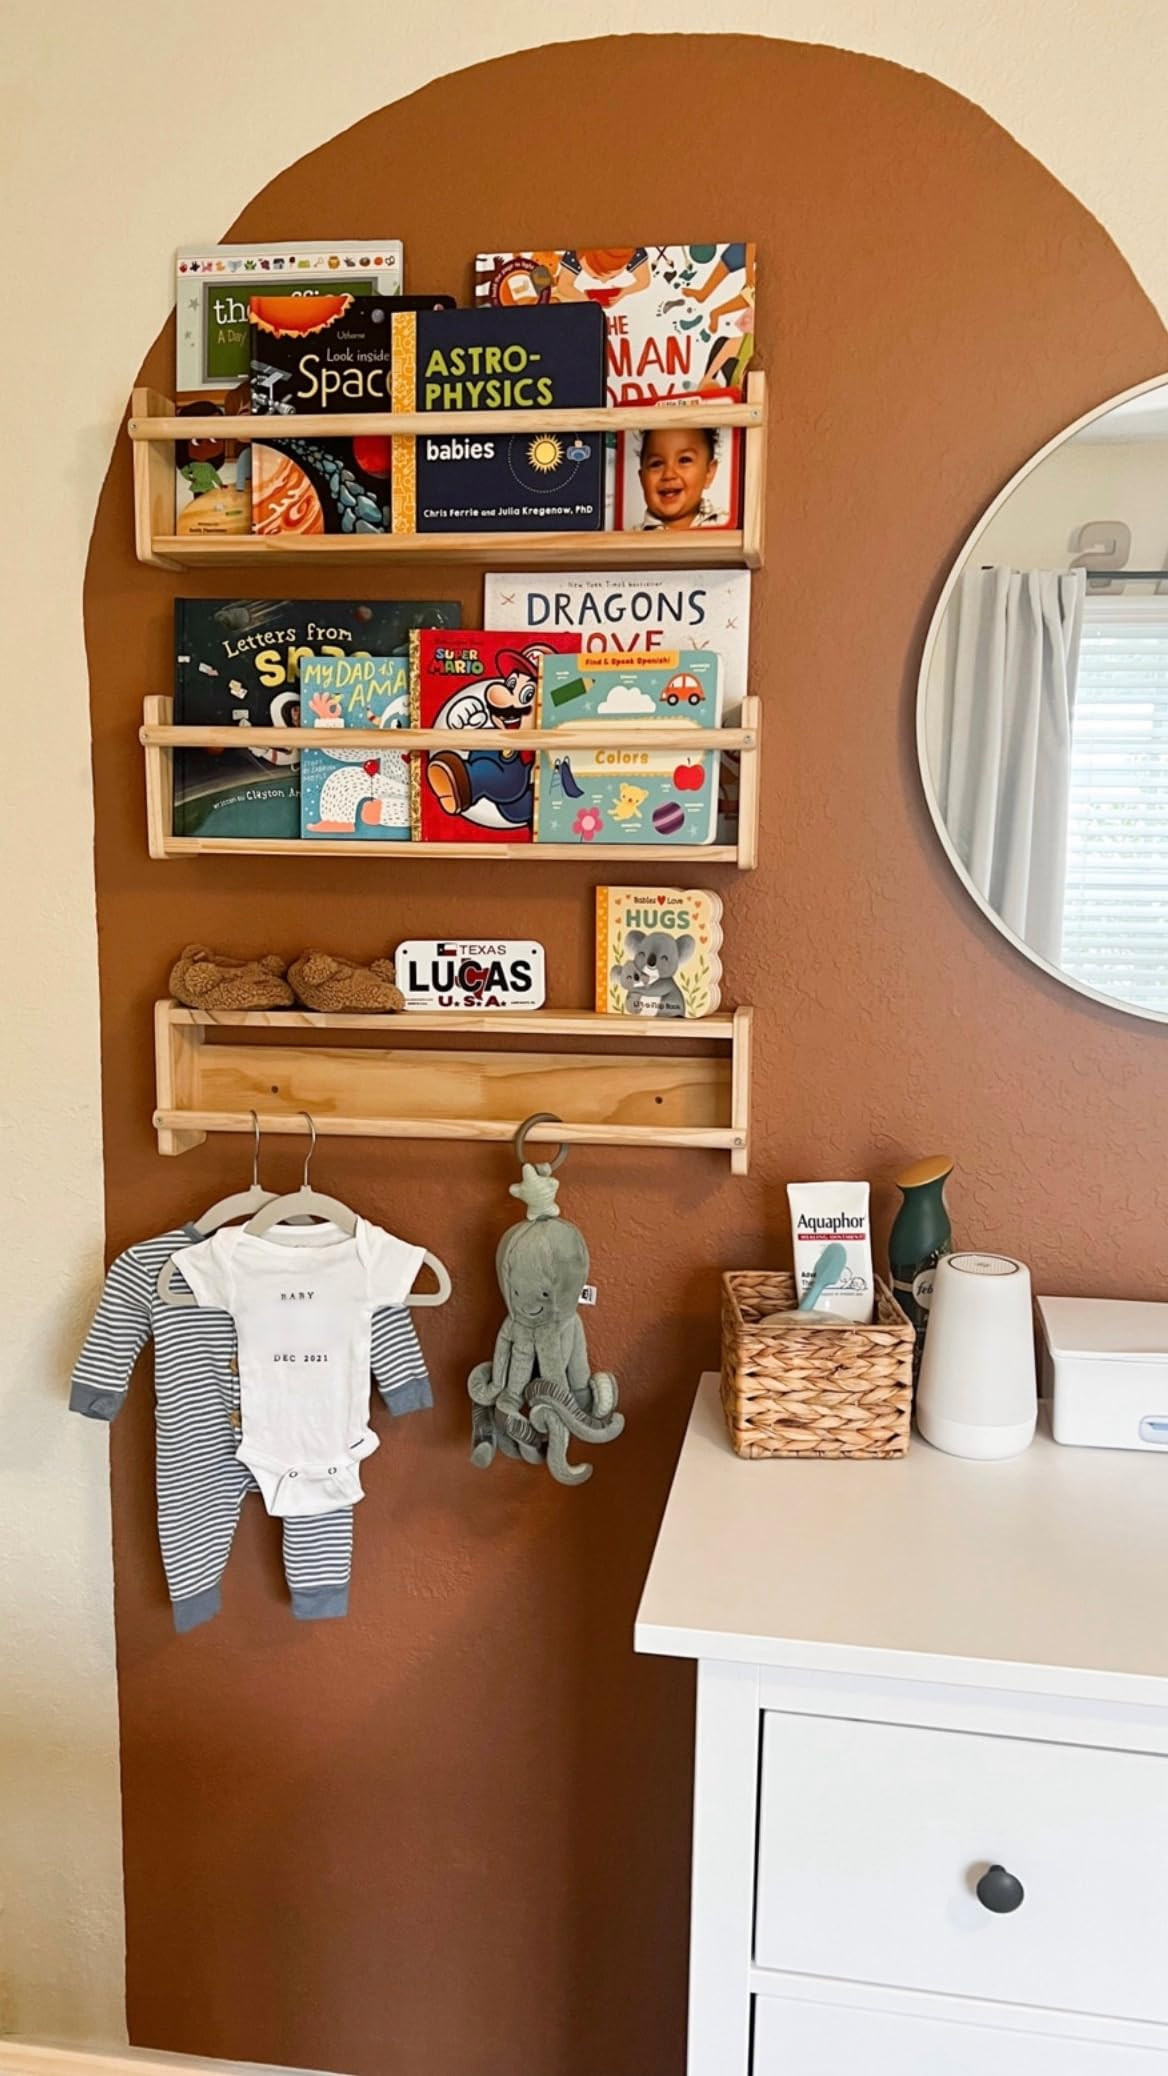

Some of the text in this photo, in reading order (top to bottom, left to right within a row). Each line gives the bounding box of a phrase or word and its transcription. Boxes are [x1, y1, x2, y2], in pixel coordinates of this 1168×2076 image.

[212, 297, 250, 325] th
[605, 315, 629, 336] HE
[217, 329, 226, 344] A
[326, 347, 354, 362] Look
[425, 345, 541, 377] ASTRO-
[425, 377, 553, 410] PHYSICS
[426, 438, 495, 461] babies
[423, 505, 593, 518] Chris Ferrie and Julia Kregenow, PhD
[527, 590, 707, 626] DRAGONS
[222, 622, 353, 659] Letters from
[586, 630, 664, 652] OVE
[435, 647, 478, 660] SUPER
[585, 658, 601, 666] Find
[611, 657, 634, 666] Speak
[637, 656, 670, 665] Spanish!
[336, 660, 376, 688] DAD
[430, 659, 484, 675] MARIO
[348, 669, 408, 713] AMA
[595, 750, 649, 764] Colors
[246, 788, 285, 800] Clayton
[633, 896, 684, 904] Babies Love
[626, 909, 690, 930] HUGS
[459, 944, 507, 955] TEXAS
[409, 960, 532, 992] LUCAS
[797, 1211, 865, 1233] Aquaphor
[281, 1291, 315, 1301] BABY
[916, 1281, 934, 1296] feb
[273, 1353, 328, 1362] DEC 2021
